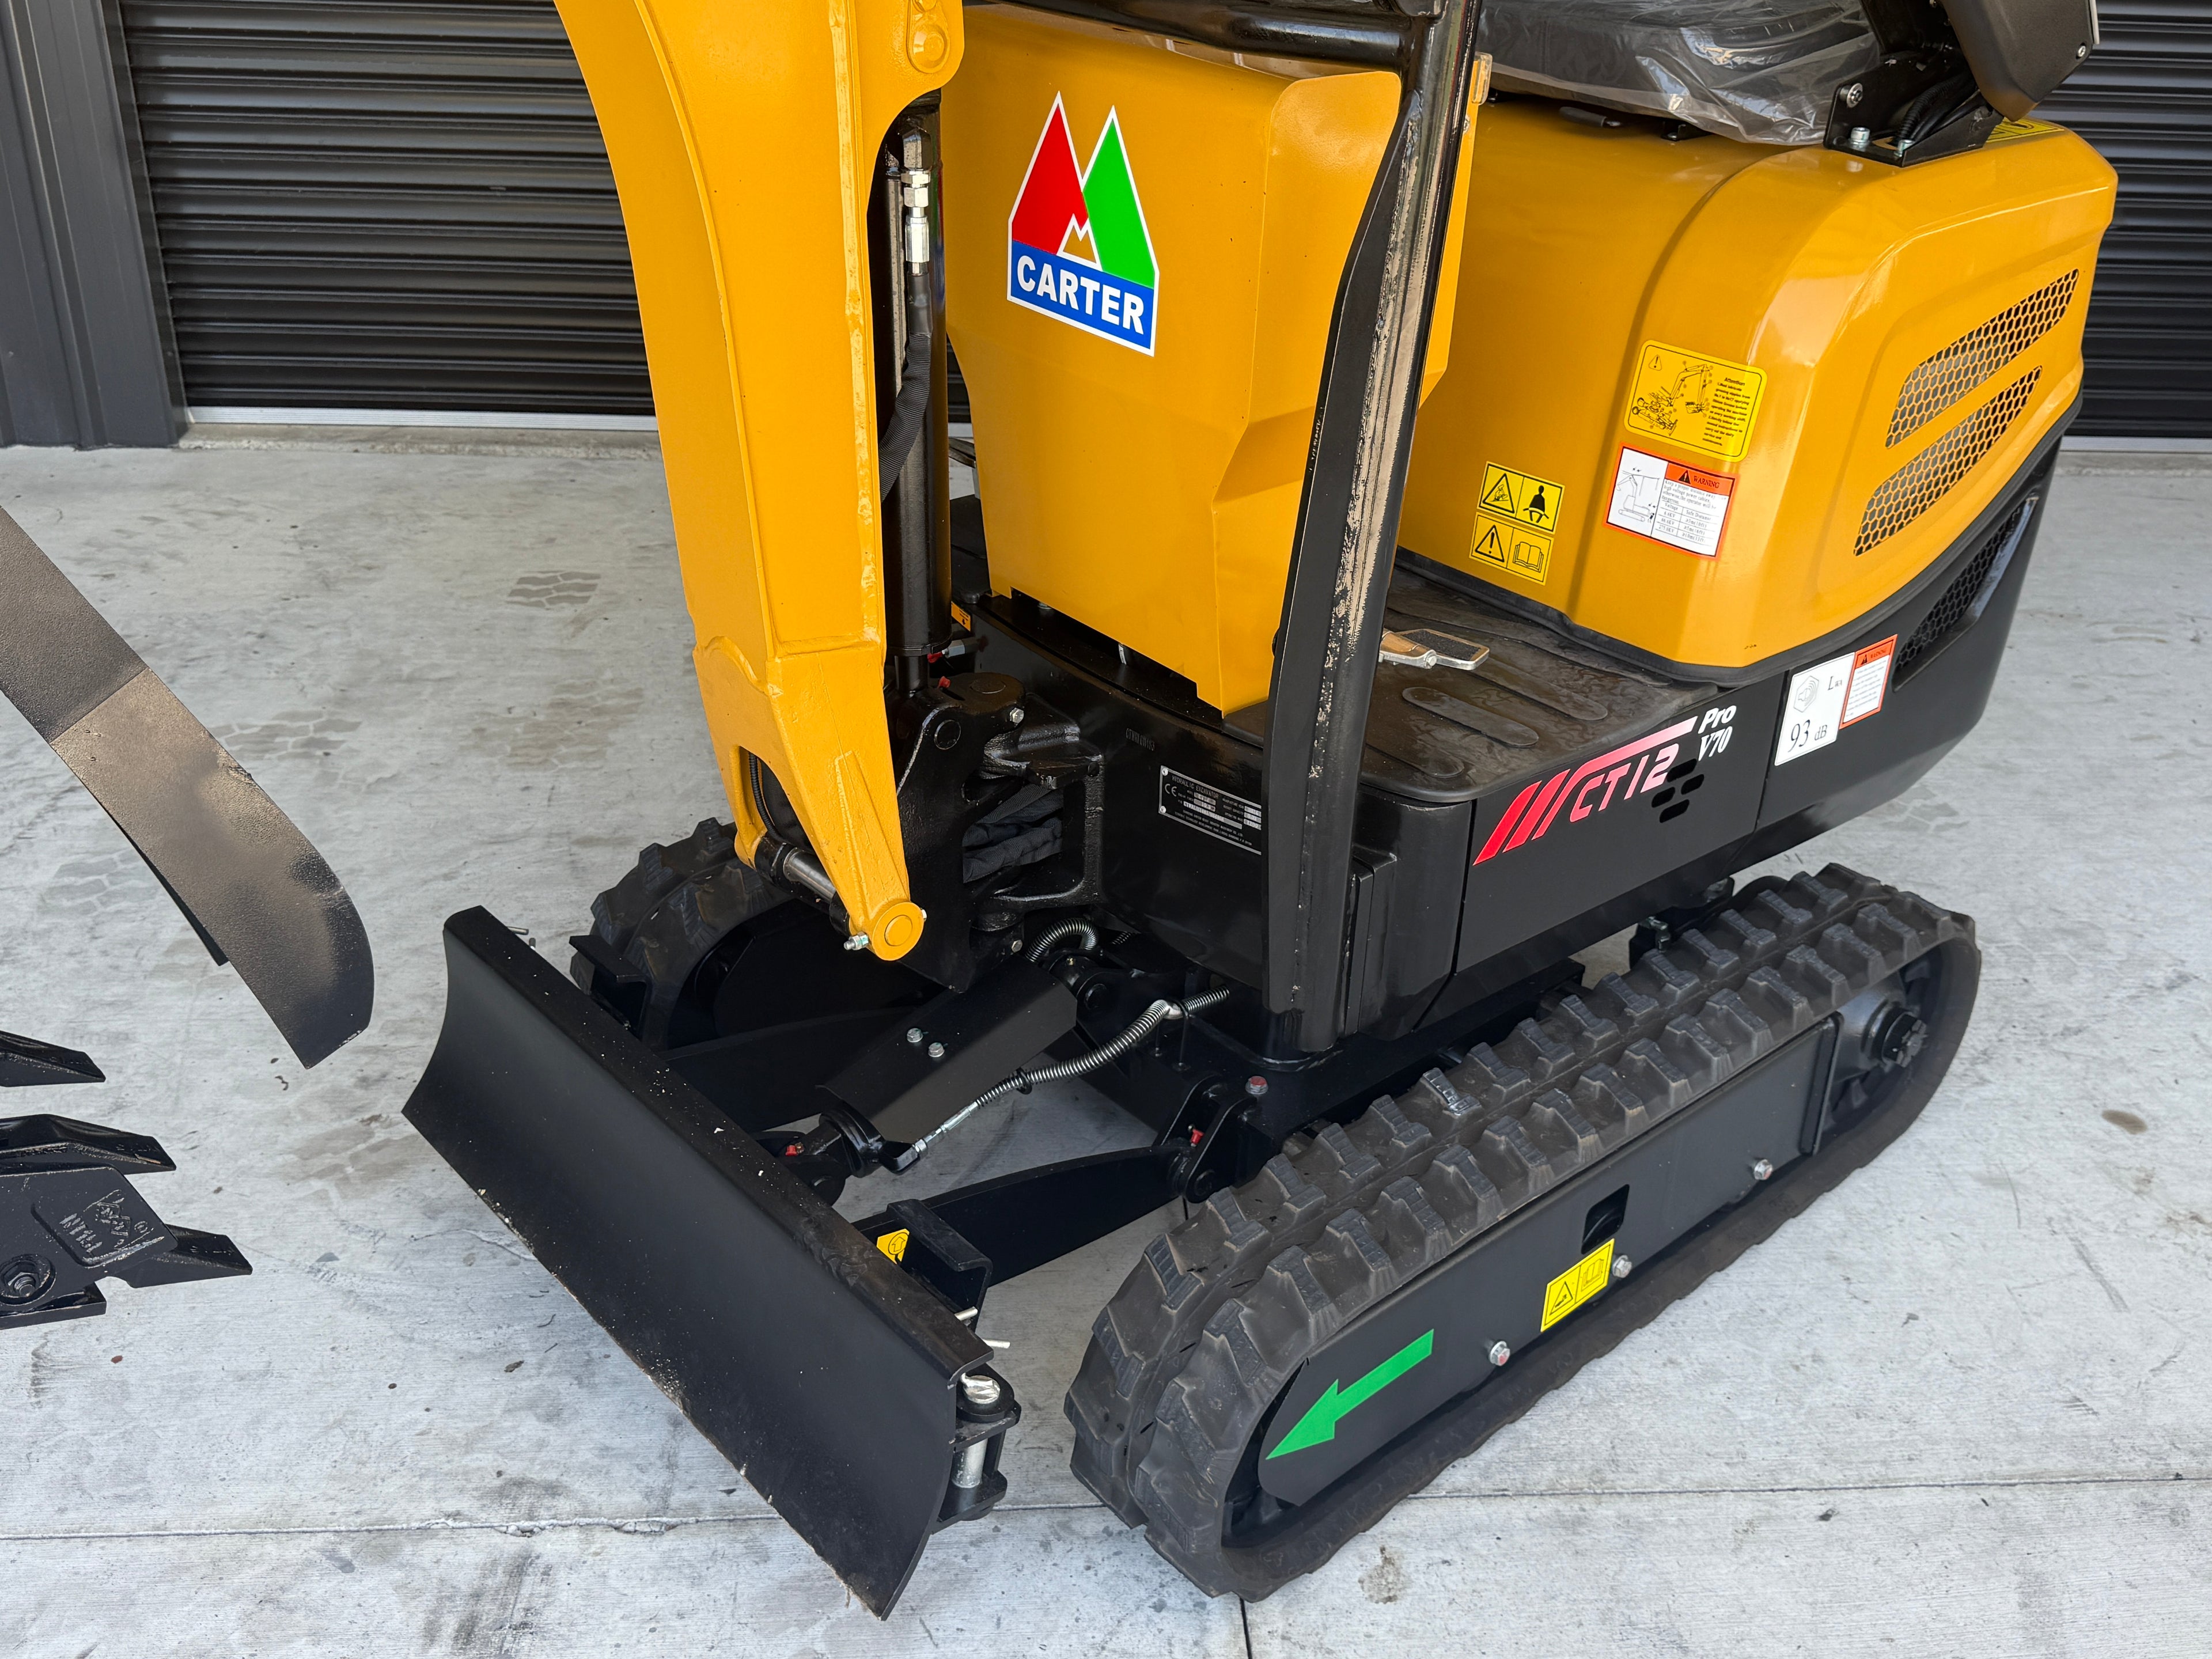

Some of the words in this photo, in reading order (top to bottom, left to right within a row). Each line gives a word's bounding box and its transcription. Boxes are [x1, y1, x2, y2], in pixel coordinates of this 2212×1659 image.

[1017, 255, 1144, 335] CARTER
[1694, 476, 1719, 488] WARNING
[1698, 705, 1737, 734] Pro
[1698, 726, 1733, 762] V70
[1787, 719, 1810, 752] 93
[1815, 725, 1827, 741] dB
[1164, 783, 1177, 797] CE
[1196, 785, 1219, 799] EXCAVATOR
[1570, 743, 1679, 823] CT12
